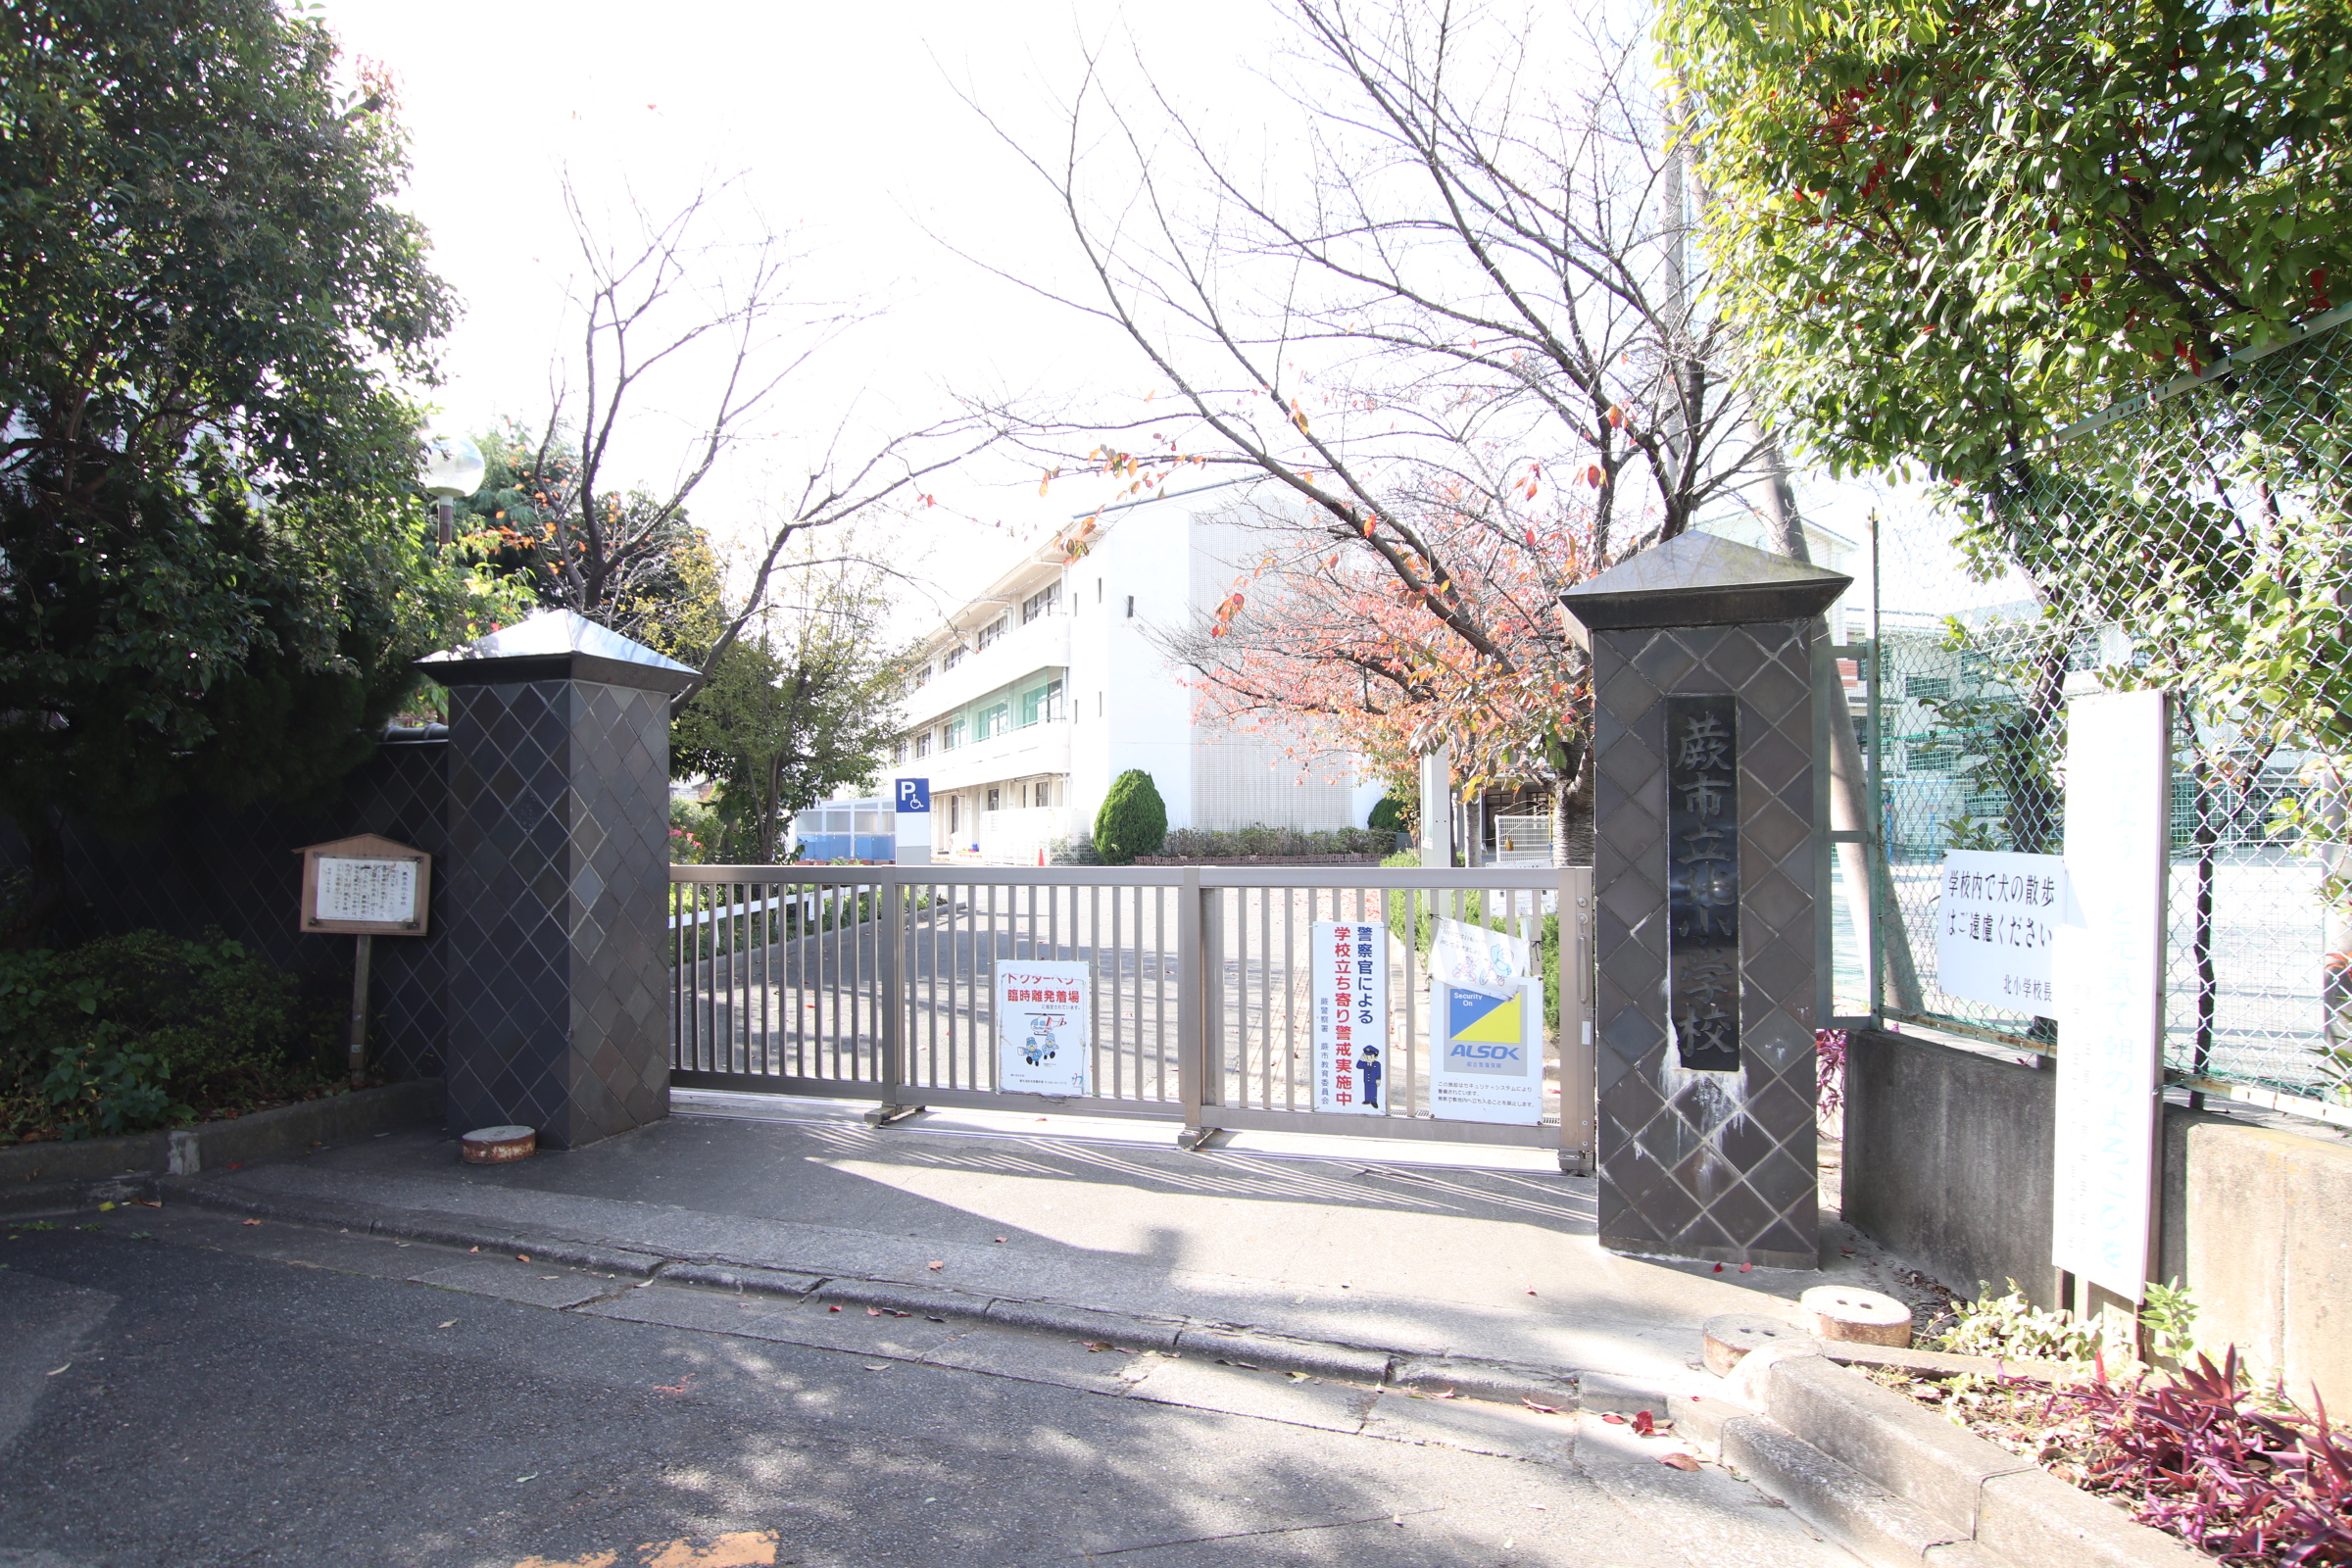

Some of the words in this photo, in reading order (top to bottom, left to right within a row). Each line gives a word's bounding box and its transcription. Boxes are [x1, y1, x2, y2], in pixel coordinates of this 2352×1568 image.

[901, 781, 916, 801] P
[1675, 710, 1736, 1056] 蕨市立北小学校
[1948, 869, 2055, 906] 学校内で犬の散歩
[1946, 908, 2052, 948] はご遠慮ください
[1357, 926, 1374, 1024] 警察官による
[2003, 974, 2052, 1003] 北小学校長
[1007, 989, 1079, 1004] 臨時離発着場
[1453, 992, 1483, 1001] Security
[1320, 998, 1329, 1033] 蕨警察署
[1334, 926, 1352, 1106] 学校立ち寄り警戒実施中
[1450, 1044, 1520, 1060] ALSOK
[1320, 1042, 1329, 1104] 蕨市教育委員会
